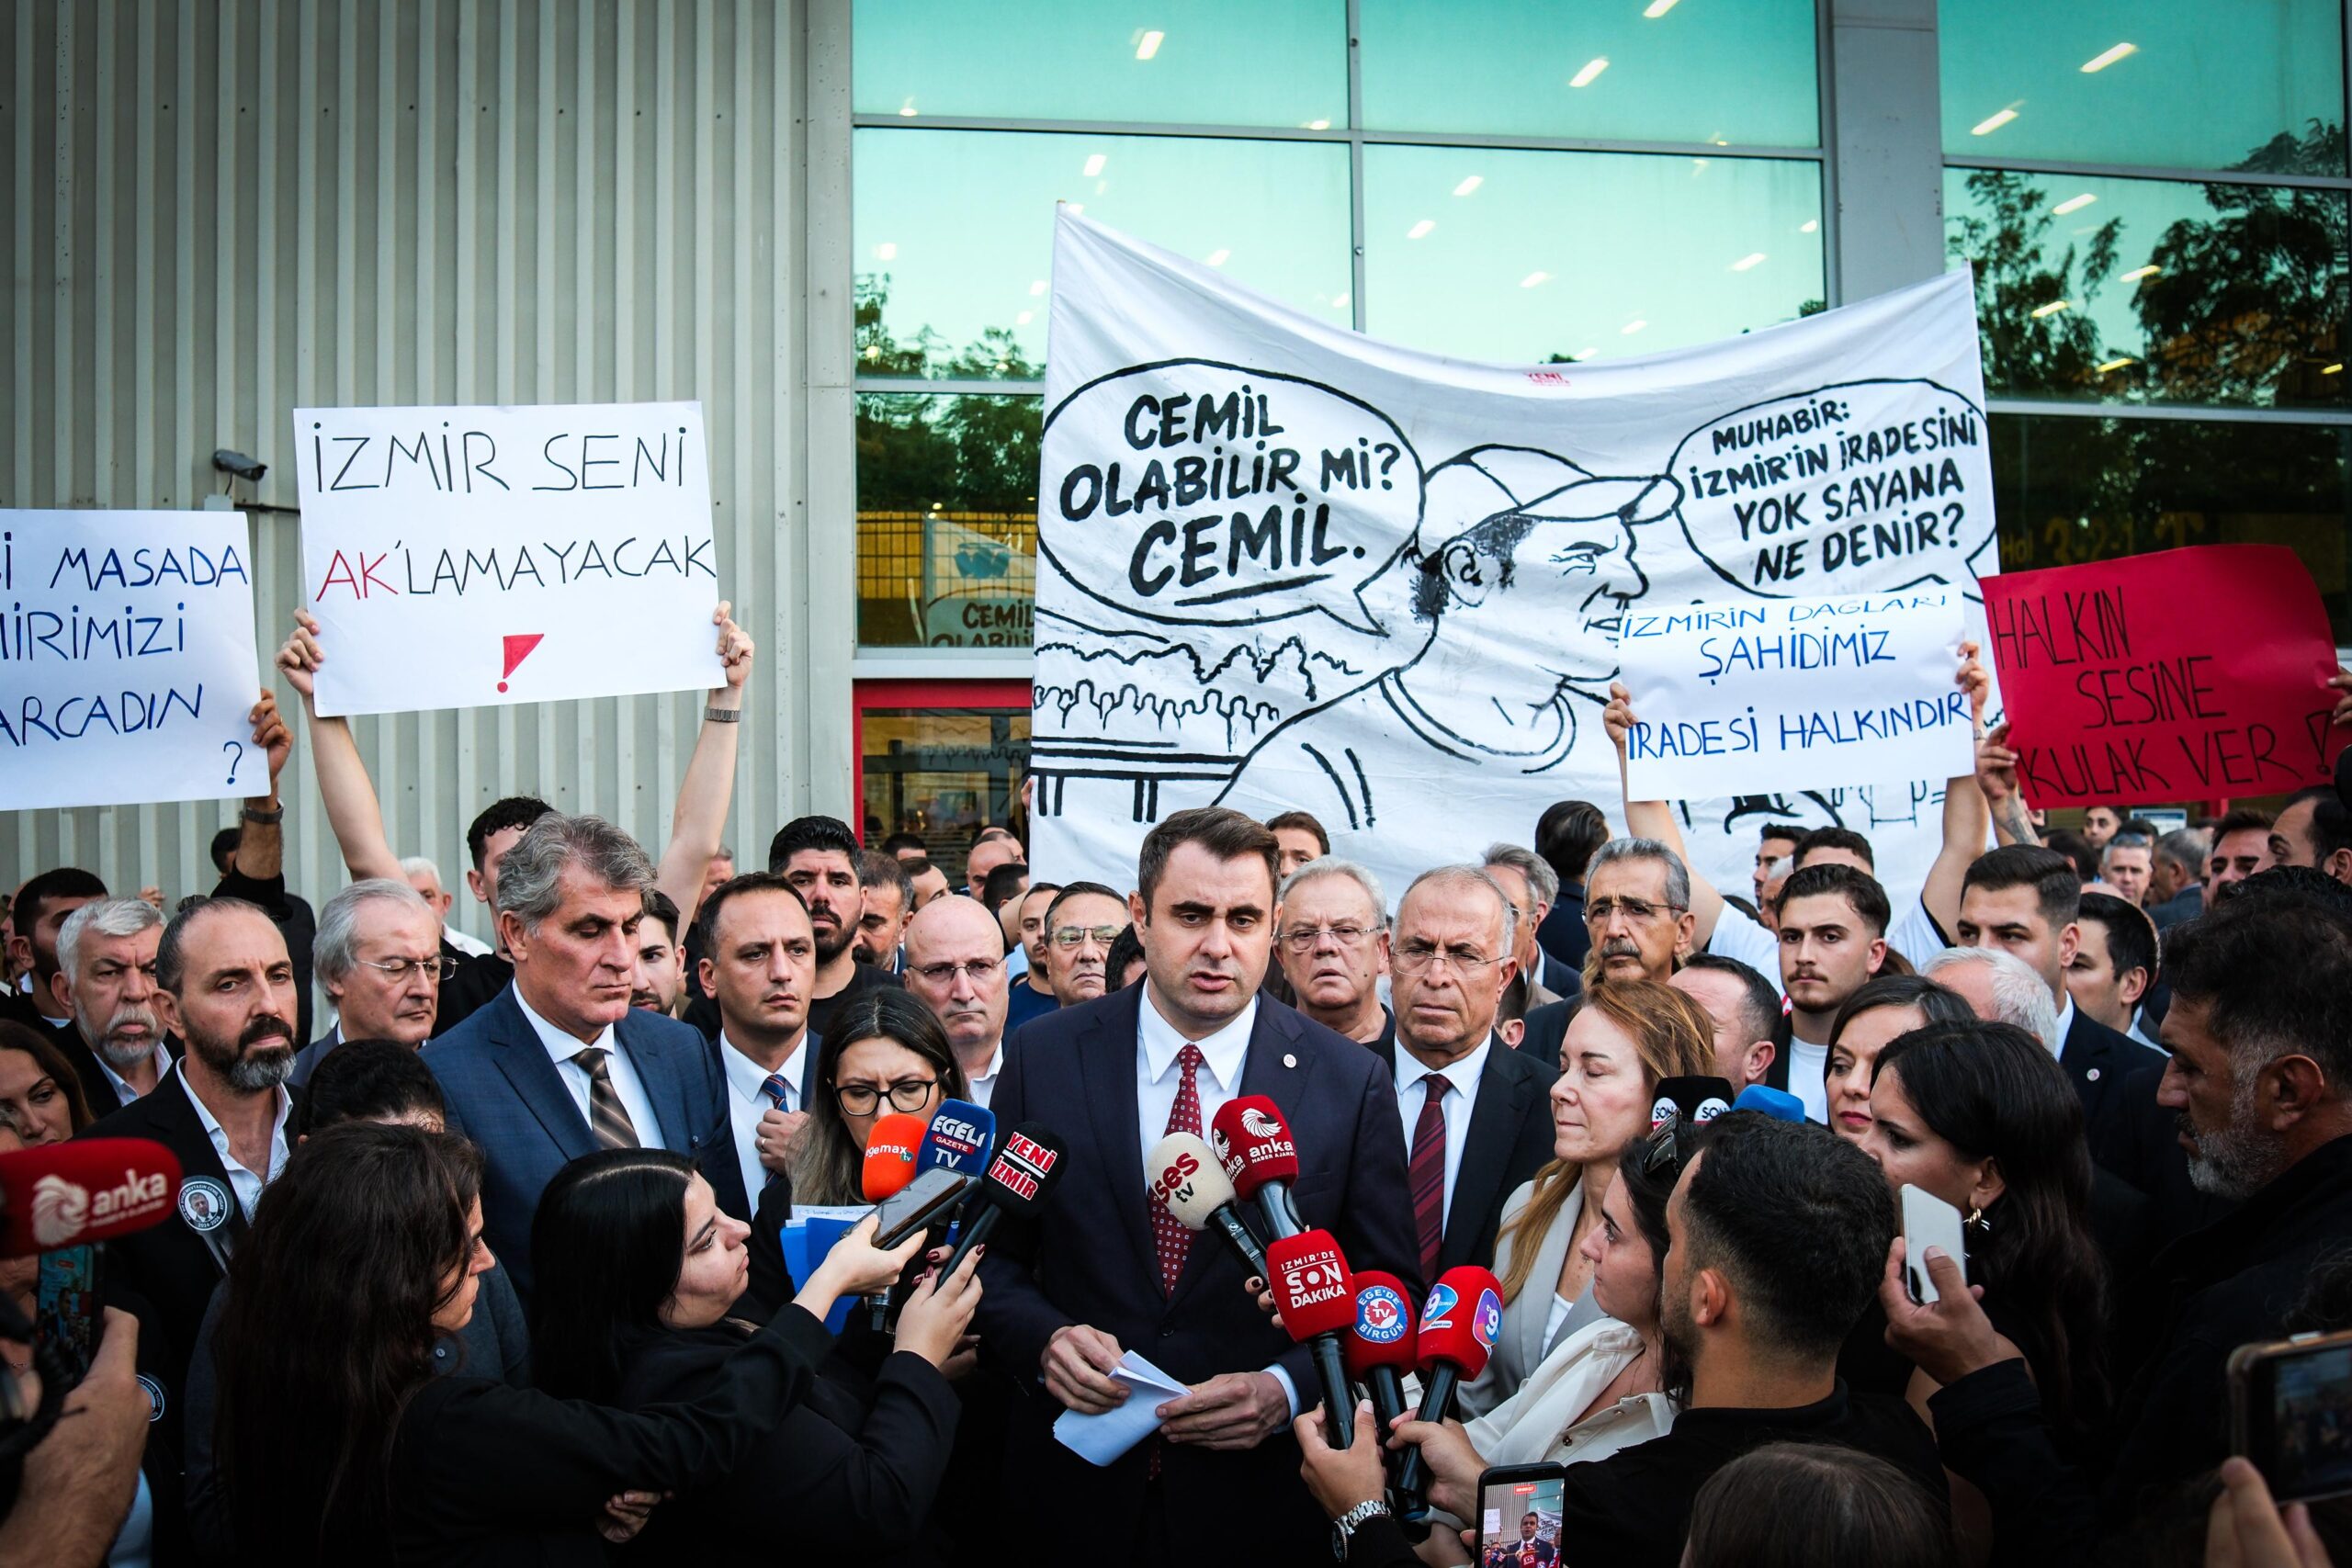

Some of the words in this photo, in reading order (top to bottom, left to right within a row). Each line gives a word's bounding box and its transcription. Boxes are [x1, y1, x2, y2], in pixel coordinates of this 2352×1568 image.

[1124, 384, 1284, 451] CEMİL
[1713, 399, 1850, 456] MUHABİR:
[313, 421, 510, 493] İZMİR
[532, 426, 687, 491] SENİ
[1059, 439, 1301, 522] OLABİLİR
[1320, 437, 1401, 492] Mİ?
[1689, 443, 1829, 499] İZMİR'İN
[1836, 407, 1978, 471] İRADESİNİ
[1733, 491, 1810, 541] YOK
[1822, 457, 1964, 522] SAYANA
[0, 531, 12, 590] İ
[50, 545, 248, 591] MASADA
[1127, 493, 1366, 598] CEMİL.
[1754, 539, 1809, 585] NE
[1822, 502, 1964, 572] DENİR?
[0, 602, 184, 660] İRİMİZİ
[1623, 606, 1766, 638] İZMİRİN
[1992, 585, 2132, 670] HALKIN
[1780, 691, 1972, 750] HALKINDIR
[2076, 656, 2227, 729] SESİNE
[223, 740, 243, 785] ?
[2017, 738, 2172, 799] KULAK
[2178, 723, 2304, 786] VER
[935, 1135, 969, 1152] GAZETE
[935, 1147, 962, 1168] TV
[1006, 1131, 1057, 1173] YENİ
[1226, 1155, 1244, 1177] nka
[1249, 1138, 1294, 1158] anka
[92, 1168, 168, 1216] anka
[988, 1156, 1038, 1201] İZMİR
[1174, 1181, 1194, 1203] tv
[1358, 1289, 1400, 1306] EGE'DE
[1373, 1308, 1391, 1319] TV
[1358, 1321, 1404, 1340] BİRGÜN
